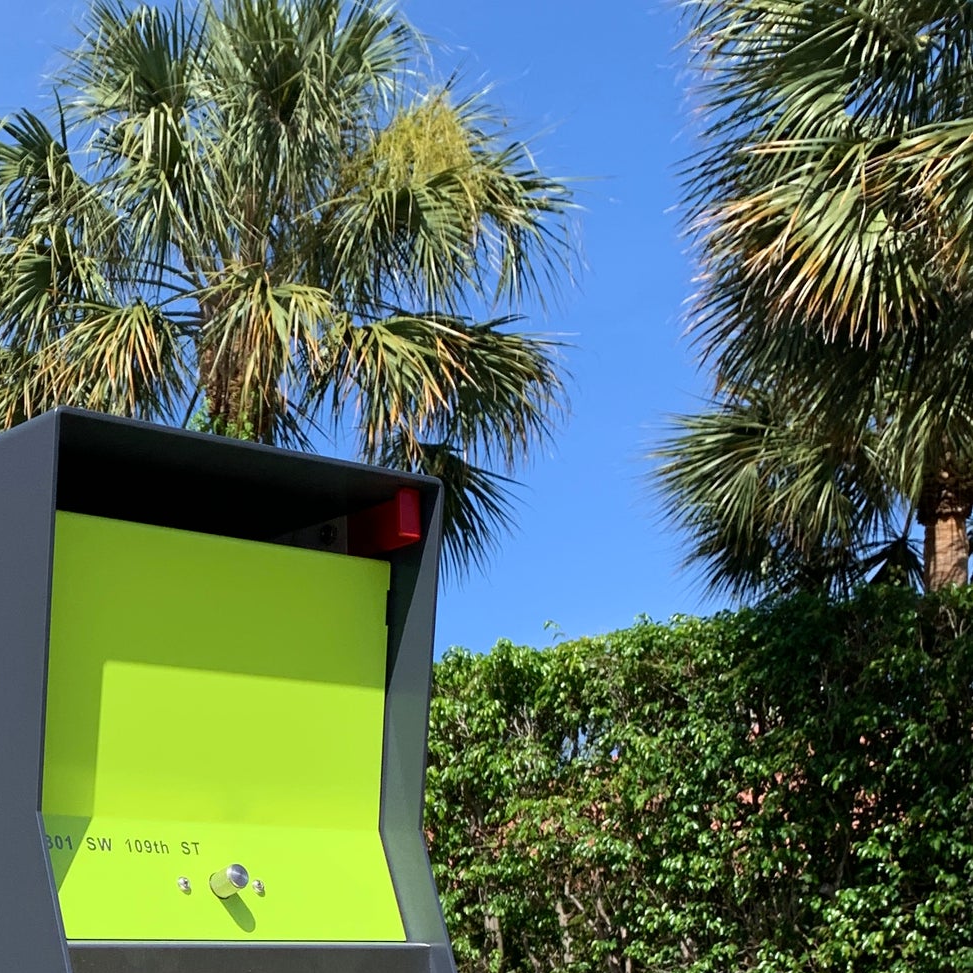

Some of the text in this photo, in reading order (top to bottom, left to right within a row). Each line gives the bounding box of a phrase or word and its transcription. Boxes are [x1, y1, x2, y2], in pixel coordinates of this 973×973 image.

[86, 836, 112, 851] SW
[124, 838, 170, 854] 109th
[180, 841, 200, 855] ST
